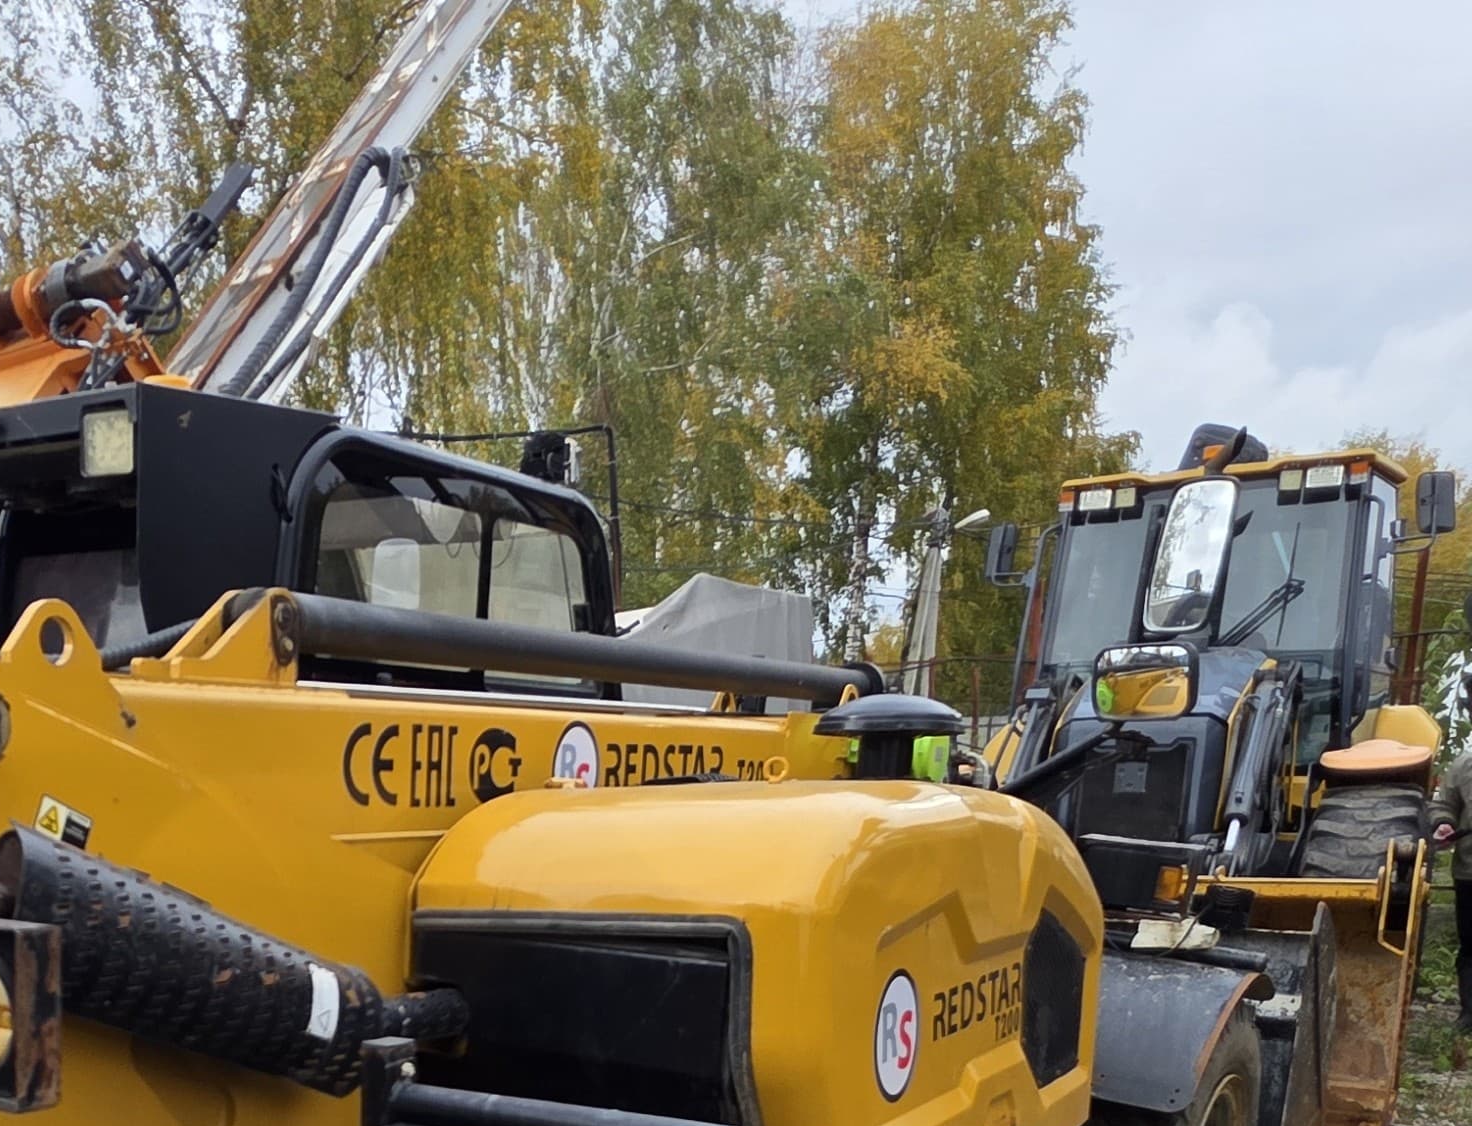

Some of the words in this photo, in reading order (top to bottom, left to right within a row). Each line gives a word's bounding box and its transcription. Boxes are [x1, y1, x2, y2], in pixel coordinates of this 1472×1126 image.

[343, 722, 399, 807] CE
[604, 743, 724, 788] REDSTAR
[881, 1001, 914, 1070] RS
[932, 962, 1021, 1042] REDSTAR
